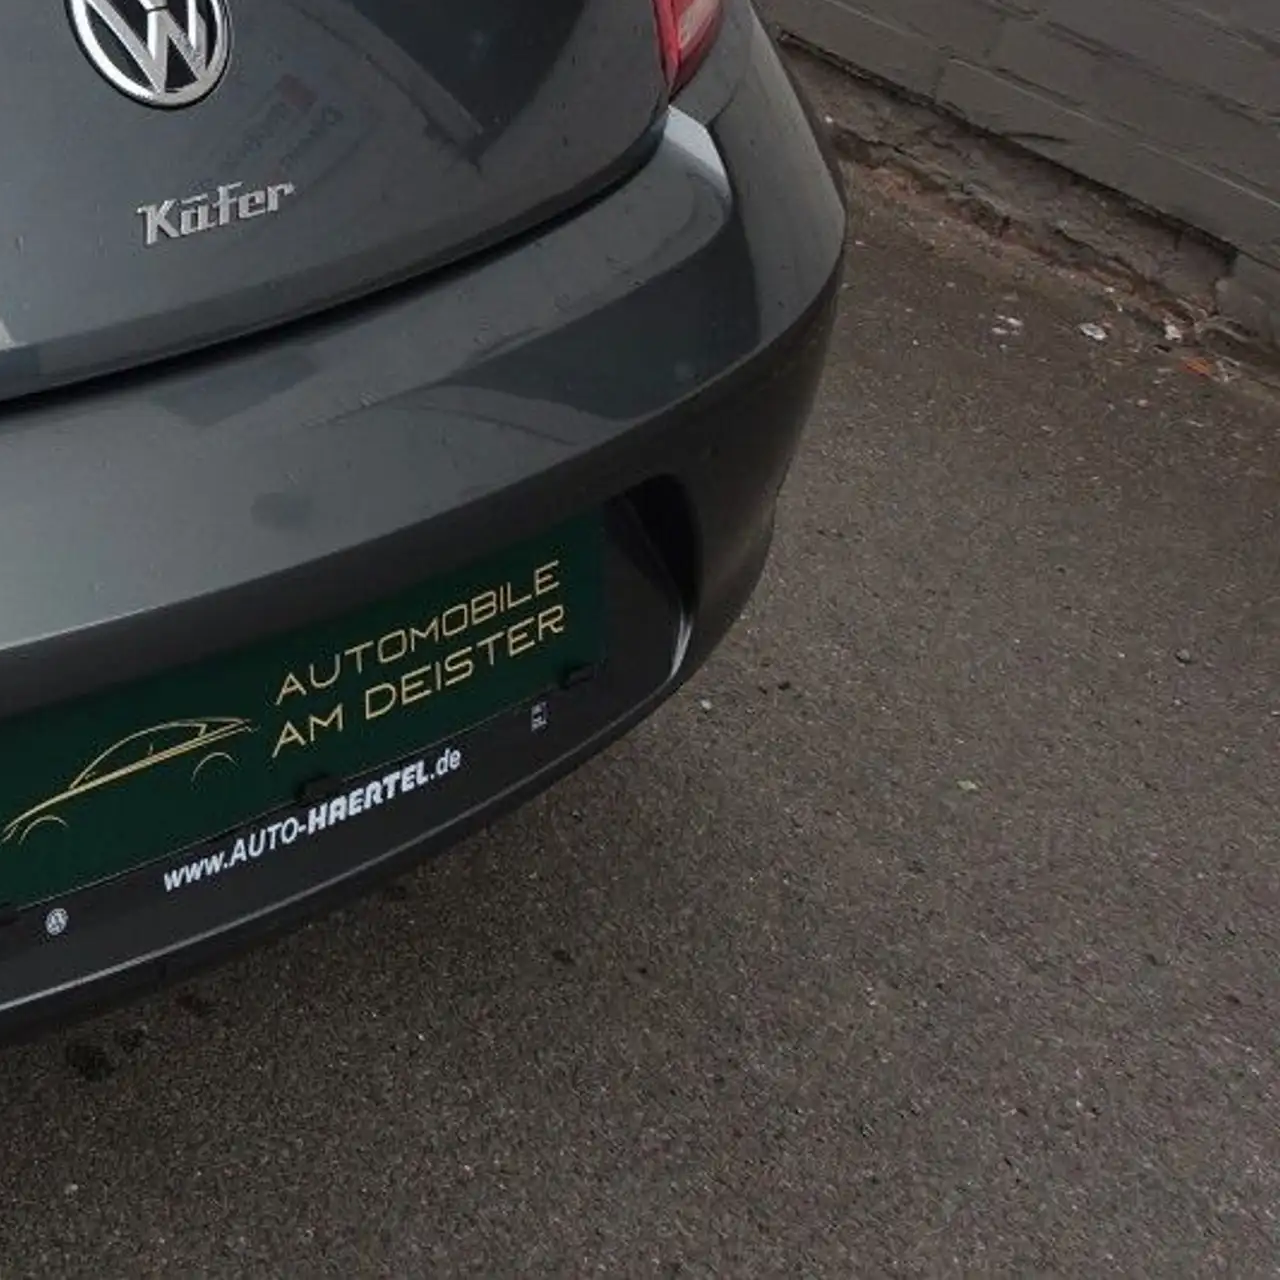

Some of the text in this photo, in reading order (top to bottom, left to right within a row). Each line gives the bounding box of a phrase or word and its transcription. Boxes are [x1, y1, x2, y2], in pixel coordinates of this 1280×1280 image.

[271, 604, 565, 759] AM DEISTER
[275, 559, 561, 707] AUTOMOBILE
